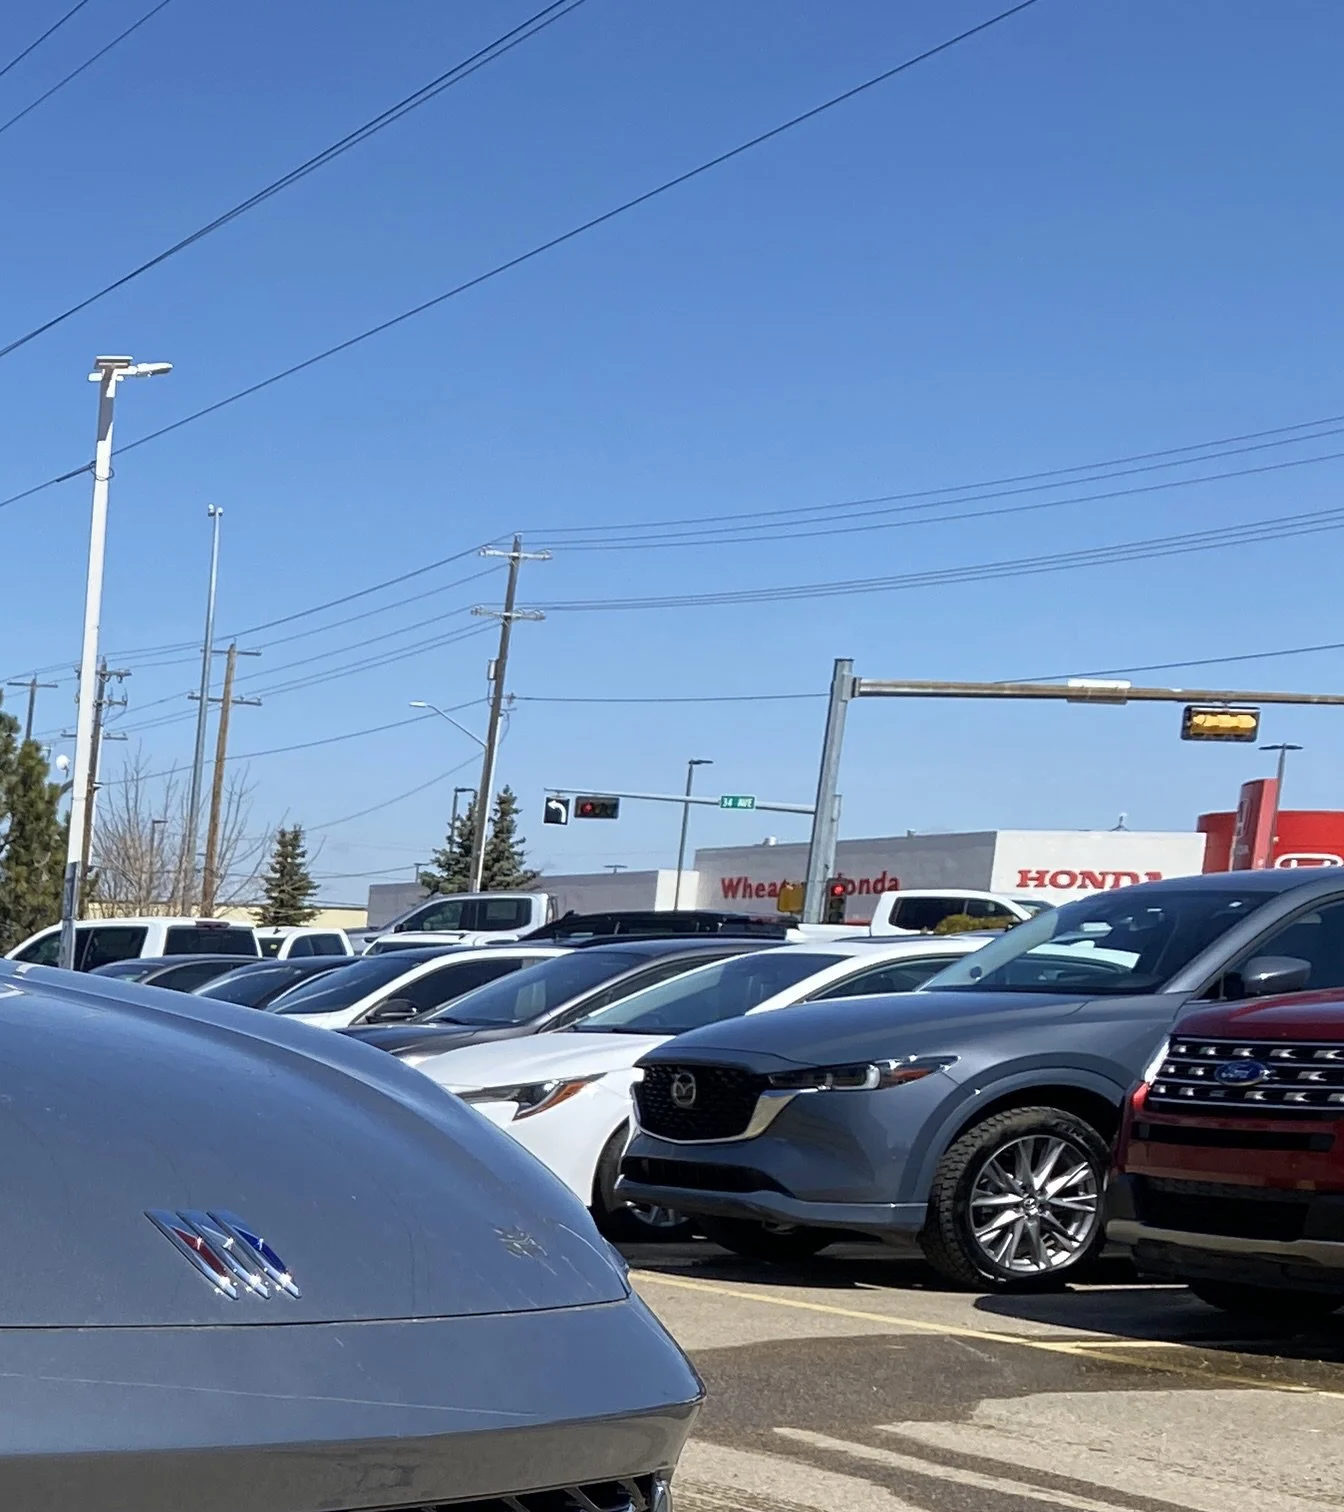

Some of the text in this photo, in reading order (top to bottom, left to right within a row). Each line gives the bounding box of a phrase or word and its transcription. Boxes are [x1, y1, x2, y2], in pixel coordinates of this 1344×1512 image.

[722, 797, 753, 808] 34 AVE
[721, 871, 900, 898] Whea onda
